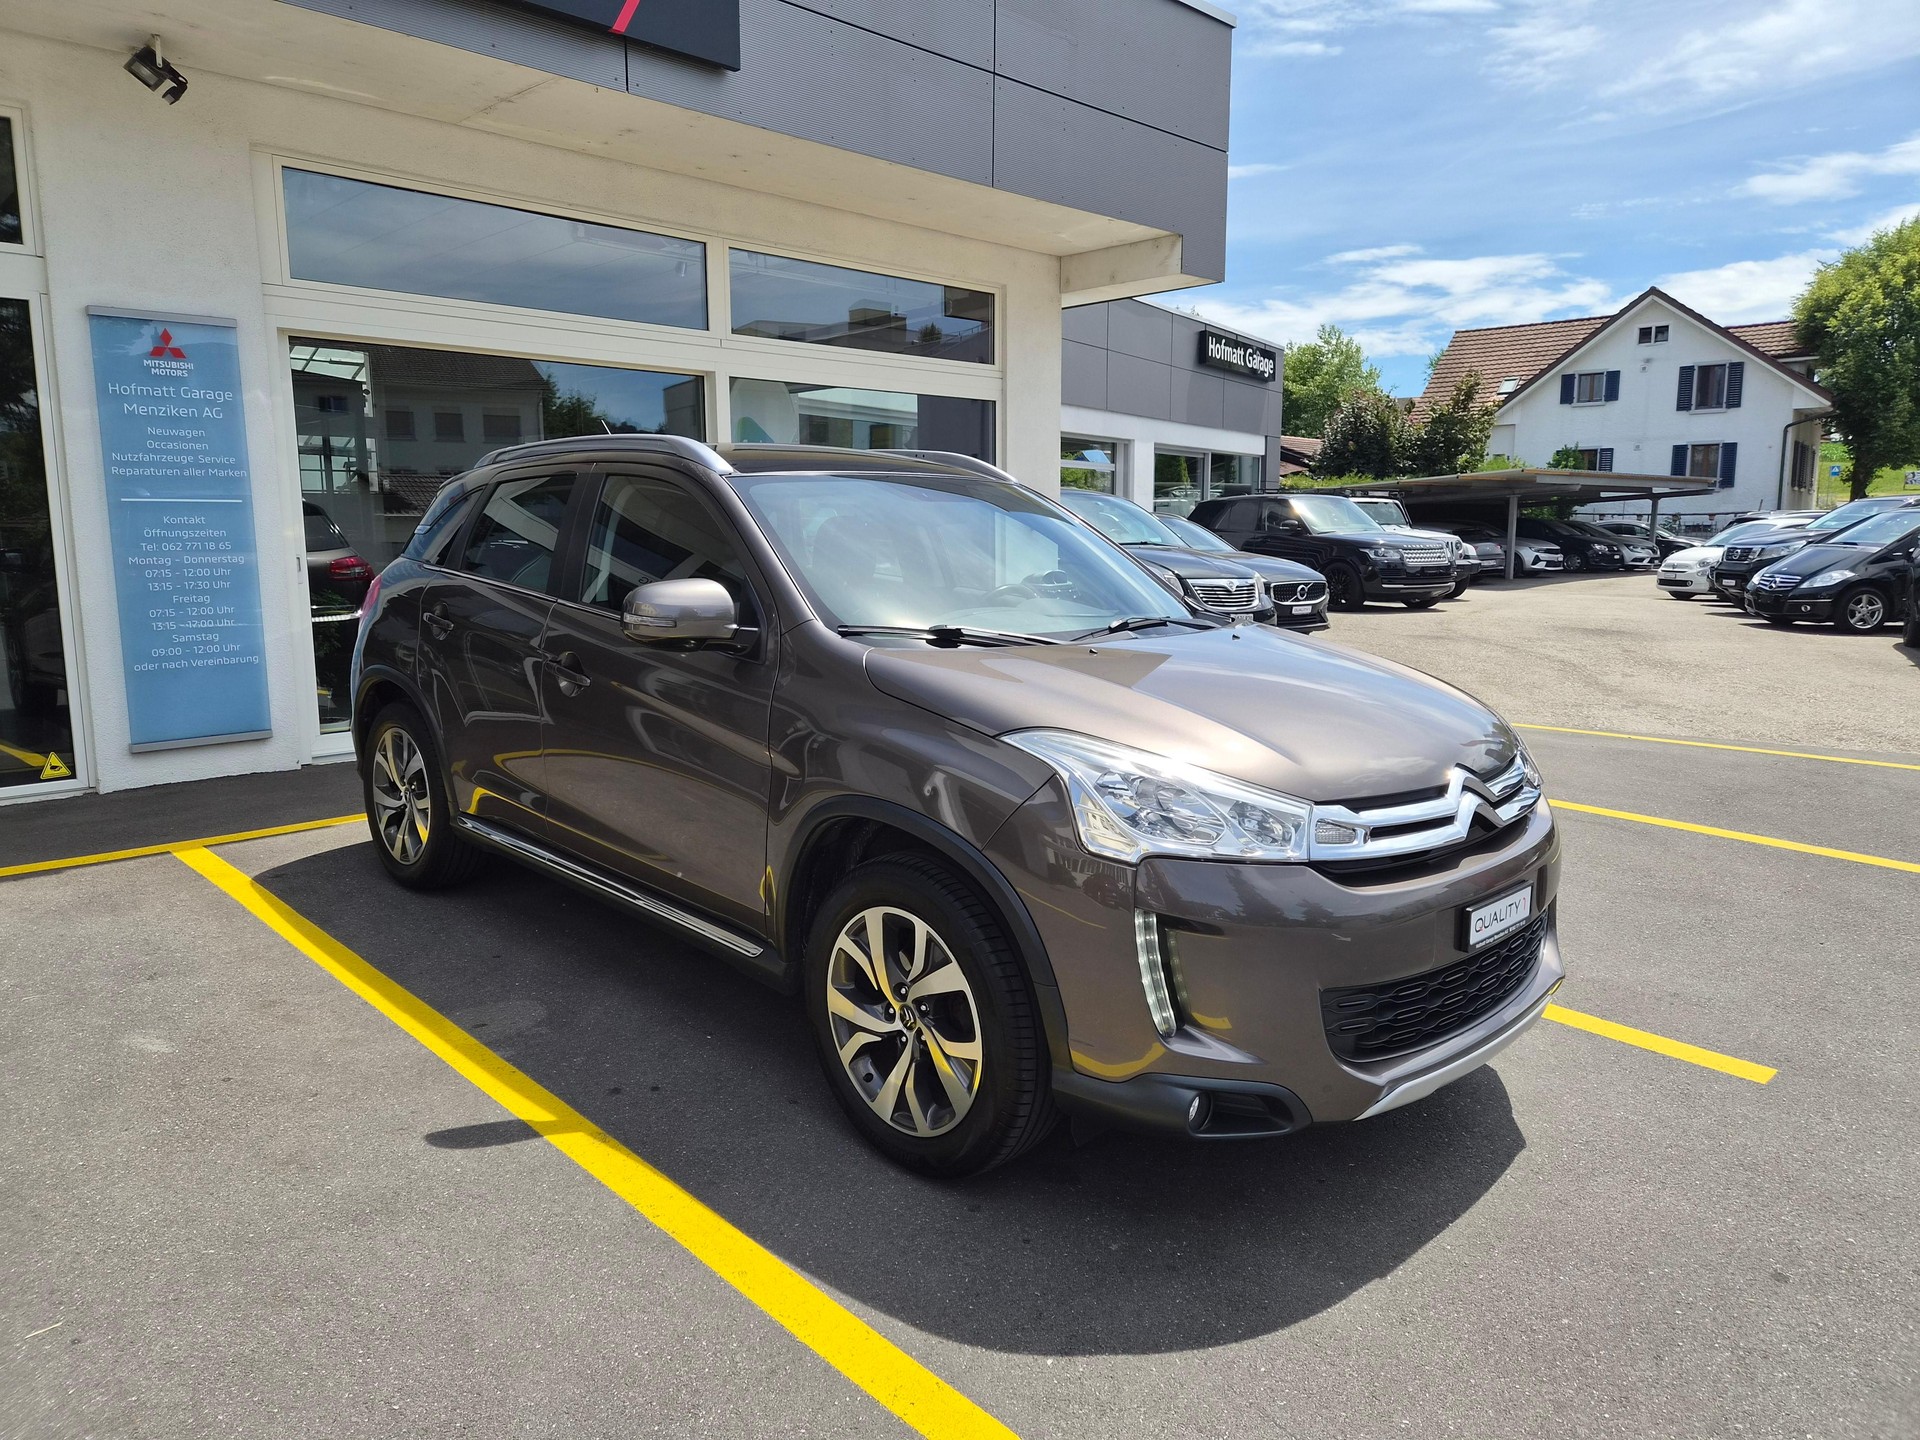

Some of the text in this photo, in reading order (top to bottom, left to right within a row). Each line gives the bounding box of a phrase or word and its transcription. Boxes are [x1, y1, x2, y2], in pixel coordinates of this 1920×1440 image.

[1208, 336, 1273, 377] Hofmatt Garage
[144, 359, 194, 370] MITSUBISHI
[151, 368, 188, 377] MOTORS
[108, 383, 233, 402] Hofmatt Garage
[123, 403, 223, 419] Menziken AG
[147, 426, 205, 438] Neuwagen
[147, 440, 209, 450] Occasionen
[112, 452, 236, 464] Nutzfahrzeuge Service
[112, 467, 247, 478] Reparaturen aller Marken
[163, 516, 206, 524] Kontakt
[144, 528, 227, 539] Öffnungszeiten
[141, 541, 232, 551] Tel: 062 771 18 65
[129, 556, 171, 566] Montag
[183, 555, 245, 564] Donnerstag
[145, 569, 172, 578] 07:15
[183, 568, 211, 577] 12:00
[213, 568, 232, 576] Uhr
[148, 582, 173, 591] 13:15
[184, 581, 210, 590] 17:30
[213, 580, 231, 589] Uhr
[173, 594, 210, 603] Freitag
[149, 608, 175, 617] 07:15
[187, 607, 214, 616] 12:00
[217, 605, 235, 614] Uhr
[152, 621, 176, 631] 13:15
[217, 619, 235, 627] Uhr
[172, 632, 219, 642] Samstag
[152, 647, 182, 657] 09:00
[193, 644, 220, 654] 12:00
[223, 643, 241, 652] Uhr
[134, 655, 259, 671] oder nach Vereinbarung
[1475, 899, 1521, 933] QUALITY
